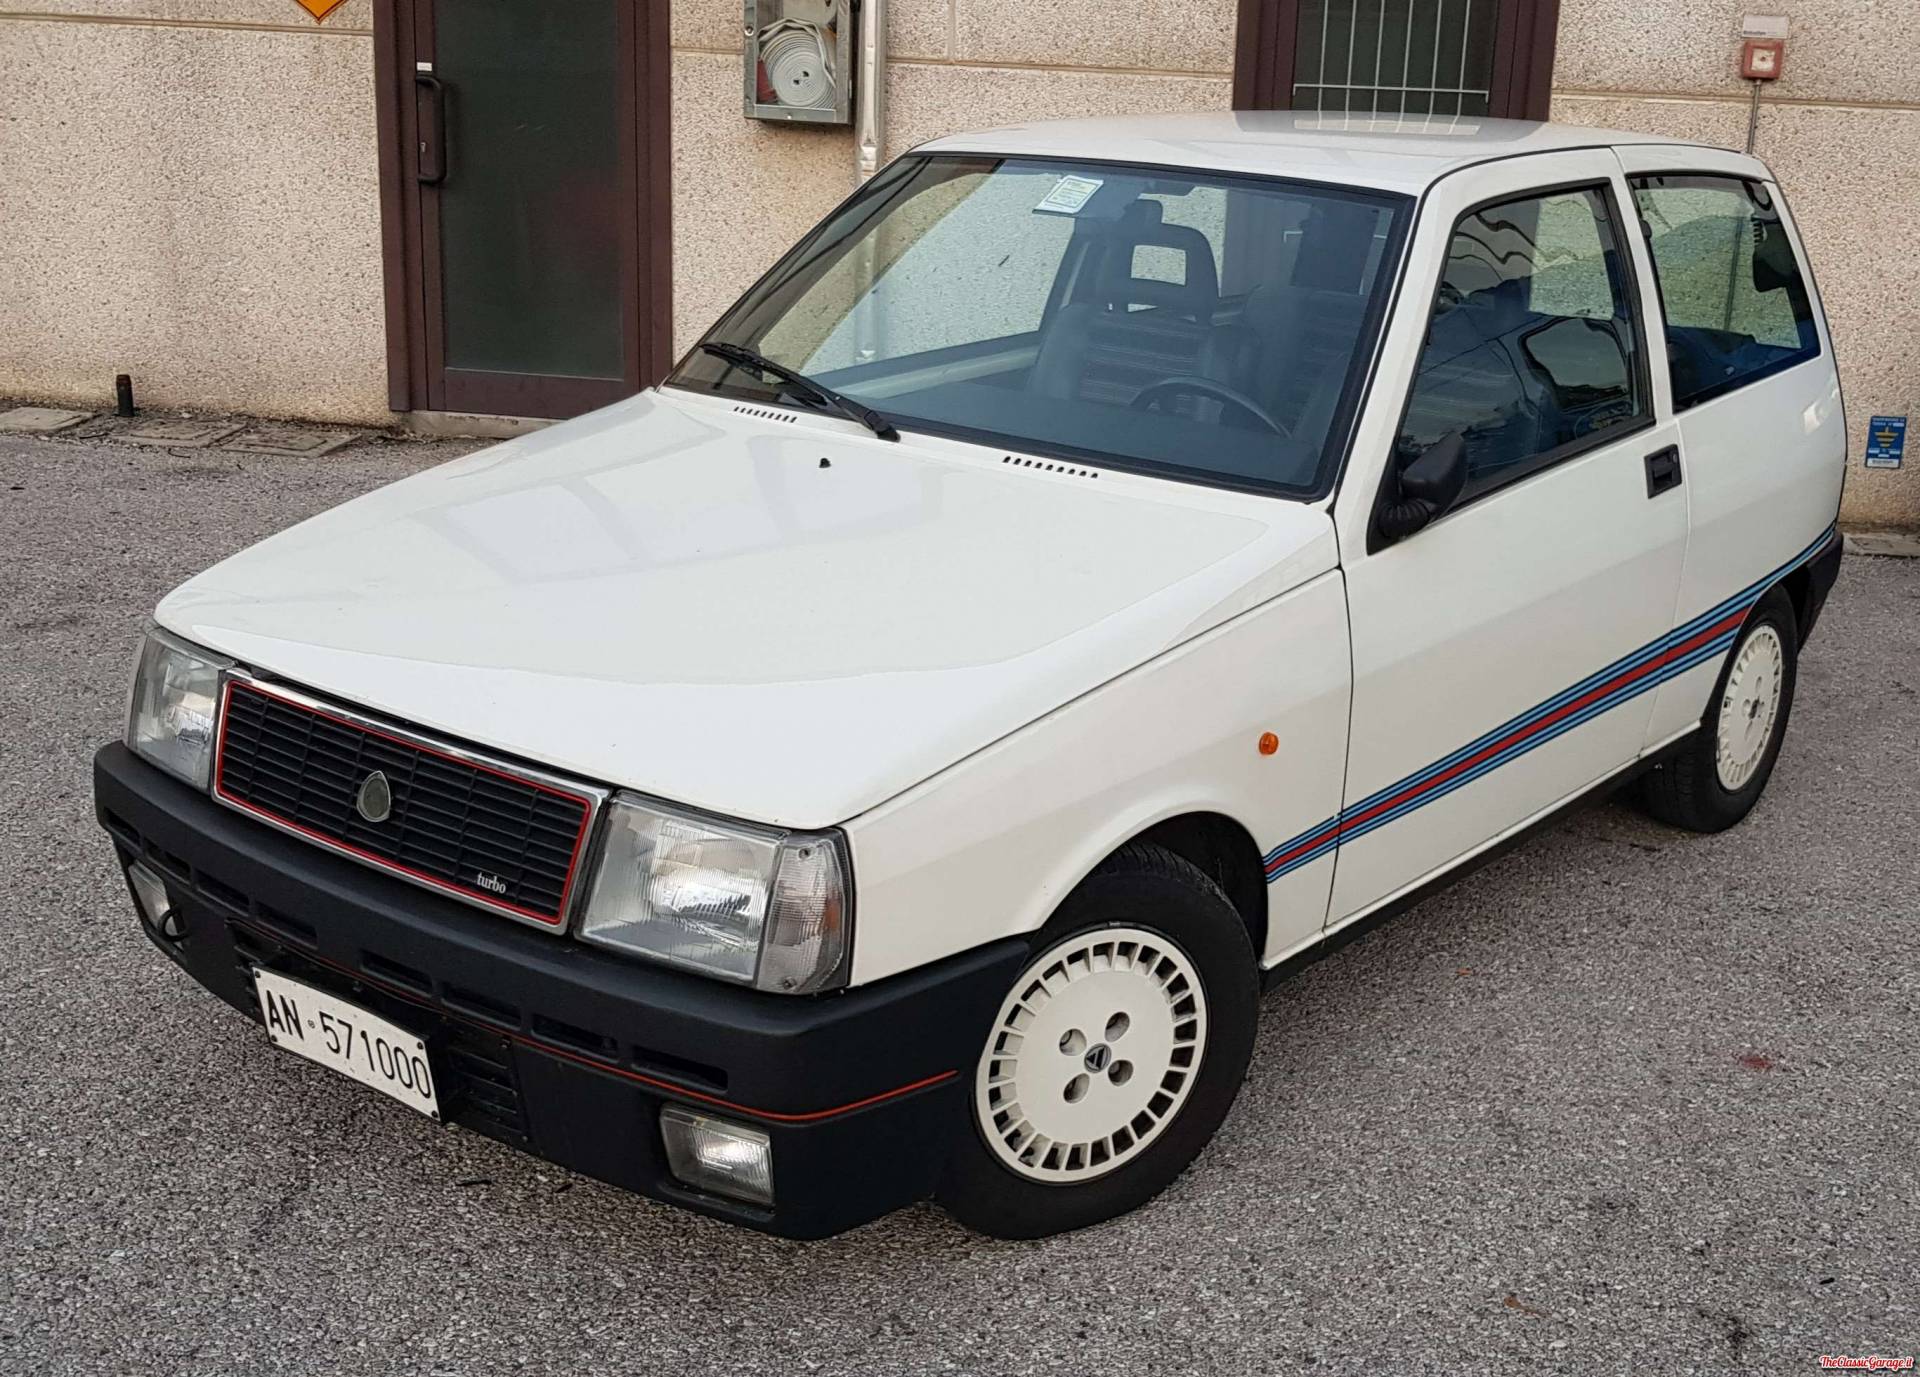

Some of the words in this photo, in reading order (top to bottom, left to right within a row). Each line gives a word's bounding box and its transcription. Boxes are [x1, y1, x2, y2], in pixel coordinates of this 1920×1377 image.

[477, 872, 506, 894] turbo
[265, 989, 304, 1040] AN
[319, 1010, 432, 1099] 571000
